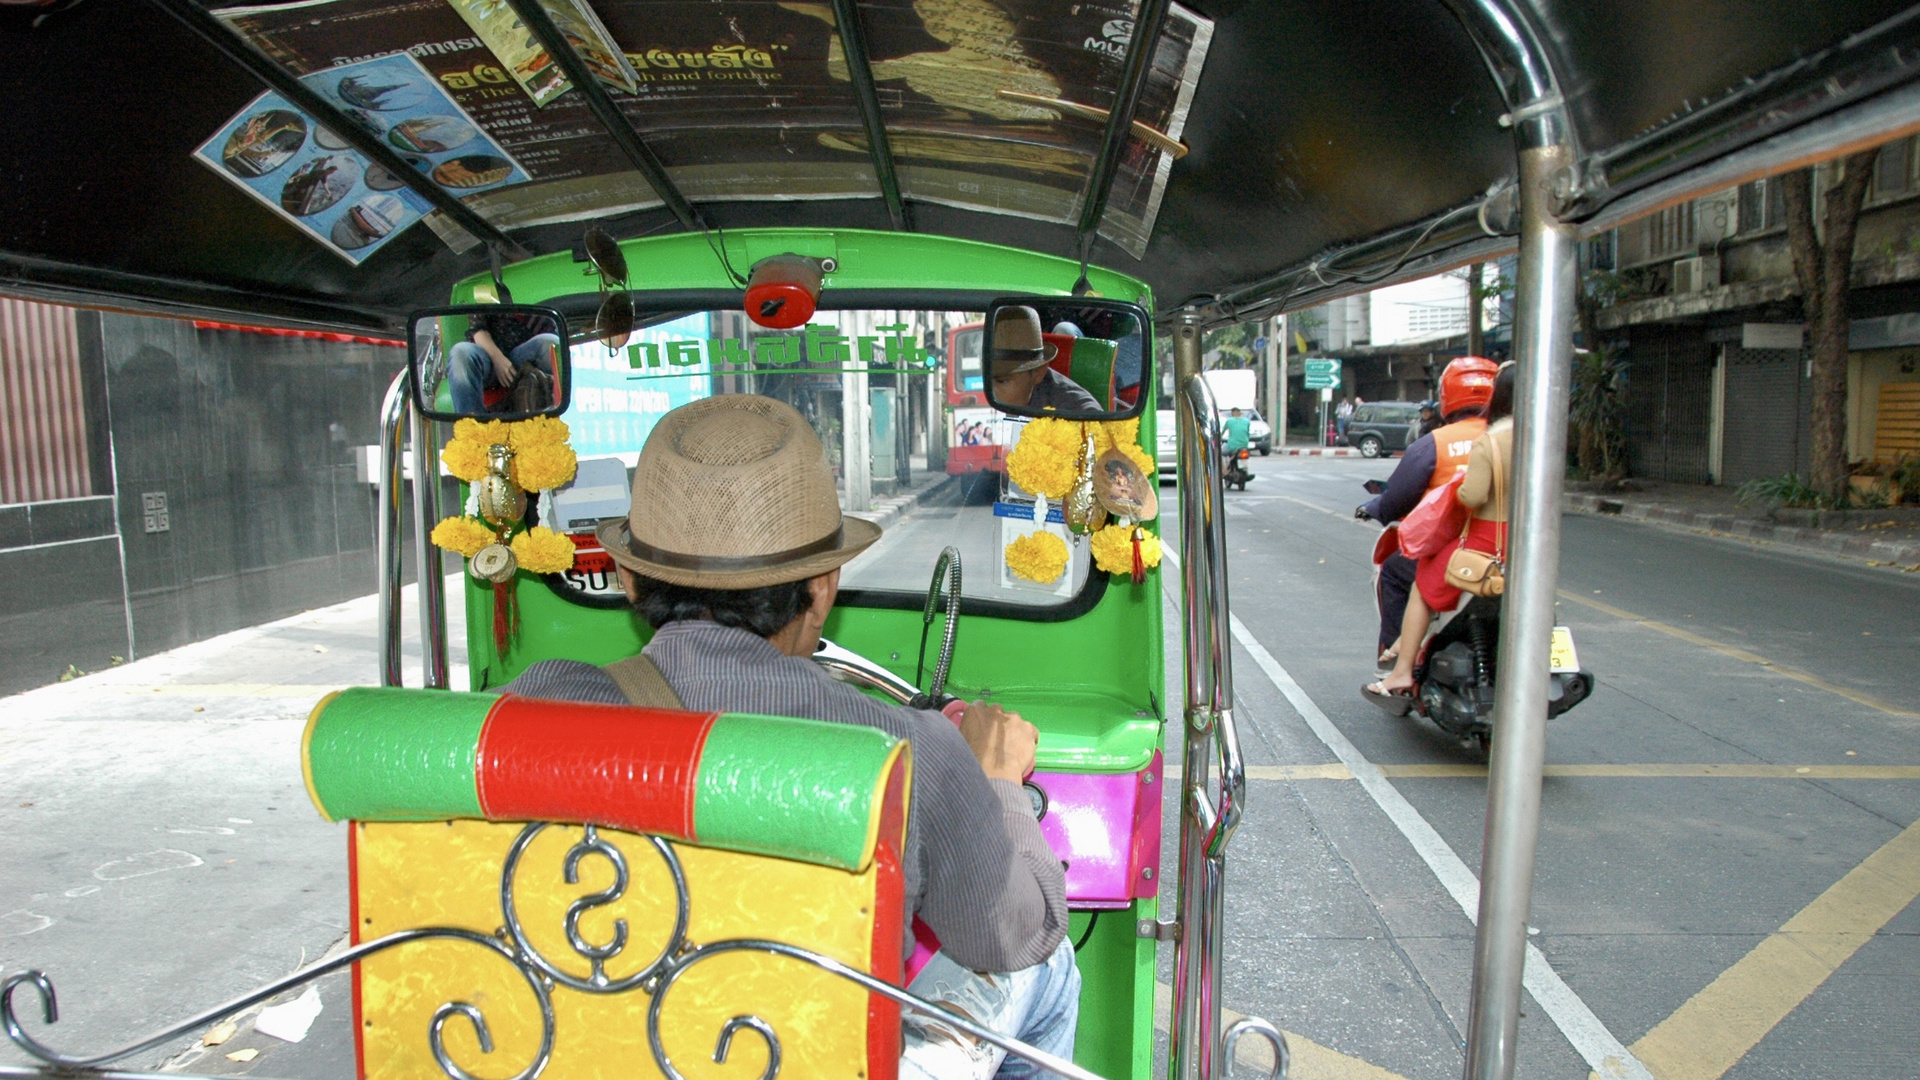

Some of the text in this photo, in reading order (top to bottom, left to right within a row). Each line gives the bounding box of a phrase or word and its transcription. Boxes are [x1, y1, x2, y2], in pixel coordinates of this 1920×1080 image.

[475, 87, 516, 99] The
[662, 71, 700, 81] and
[707, 70, 782, 80] fortune
